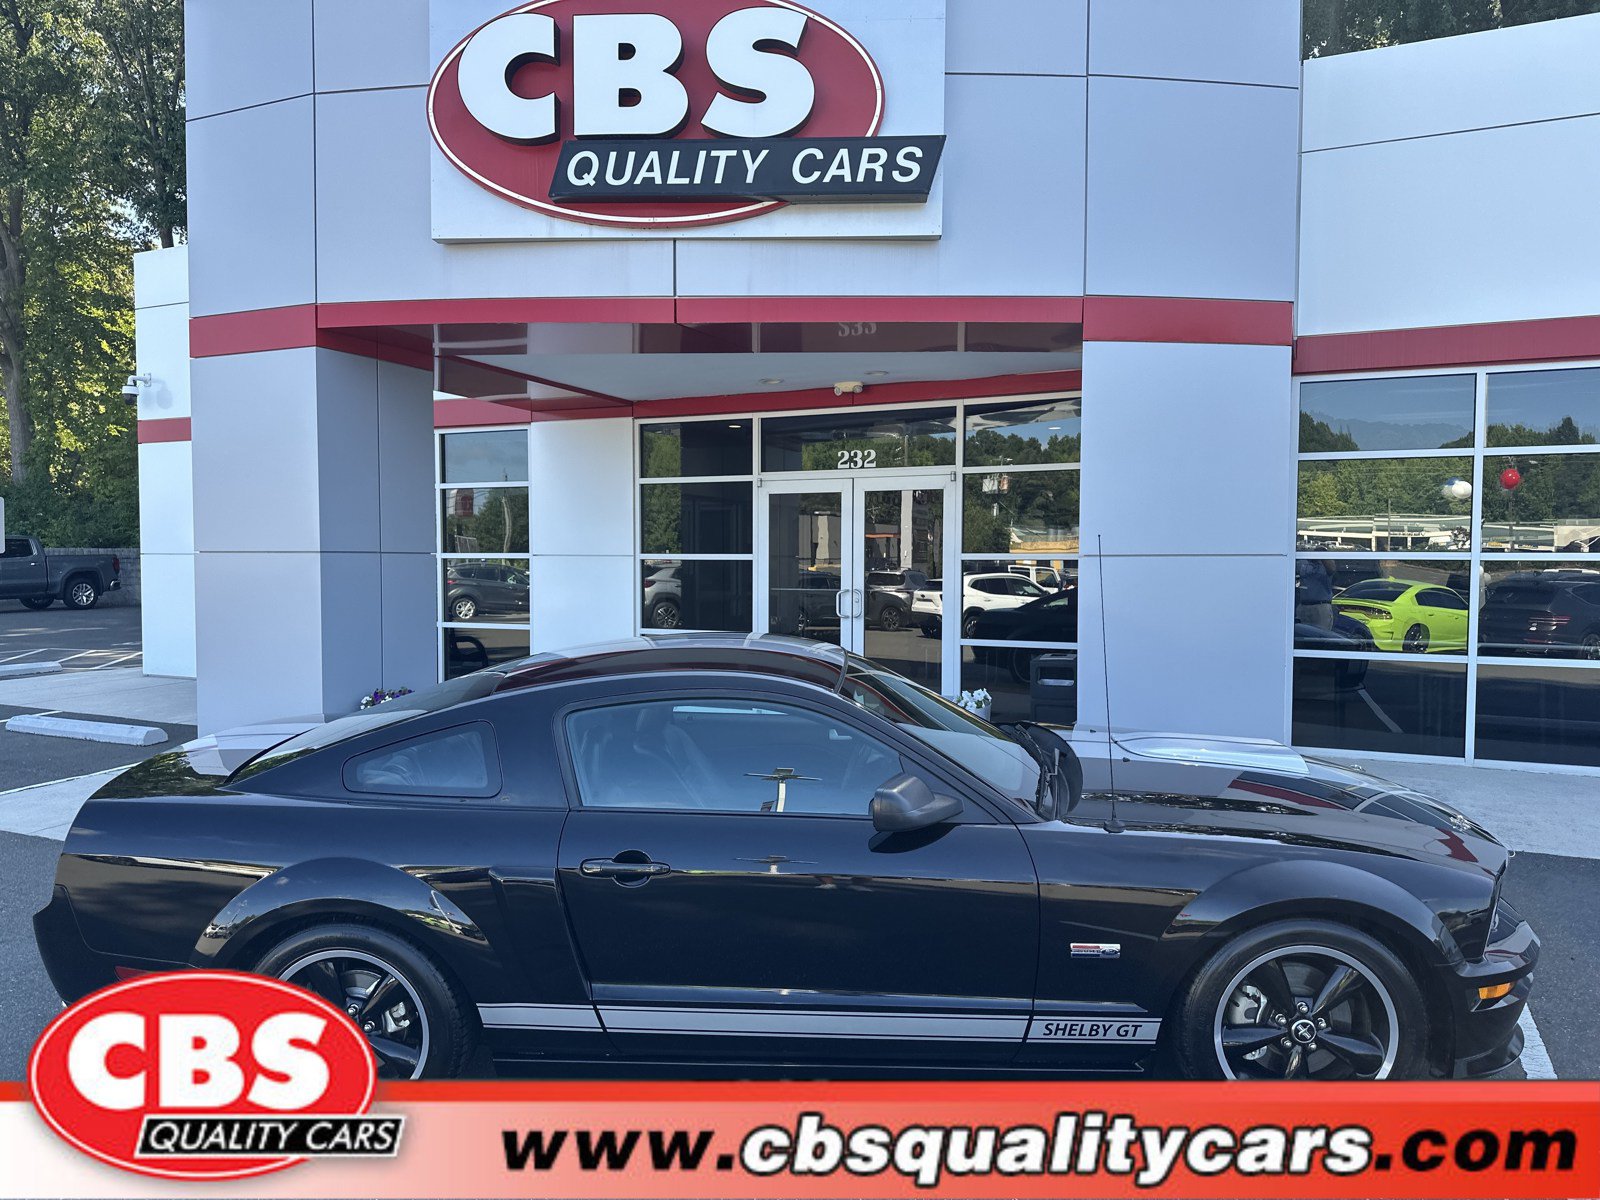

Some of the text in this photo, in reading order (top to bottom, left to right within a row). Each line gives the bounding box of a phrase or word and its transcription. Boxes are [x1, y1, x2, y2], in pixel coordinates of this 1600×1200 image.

[457, 6, 815, 143] CBS
[565, 146, 924, 187] QUALITY CARS
[837, 449, 877, 469] 232
[1043, 1022, 1142, 1037] SHELBY GT
